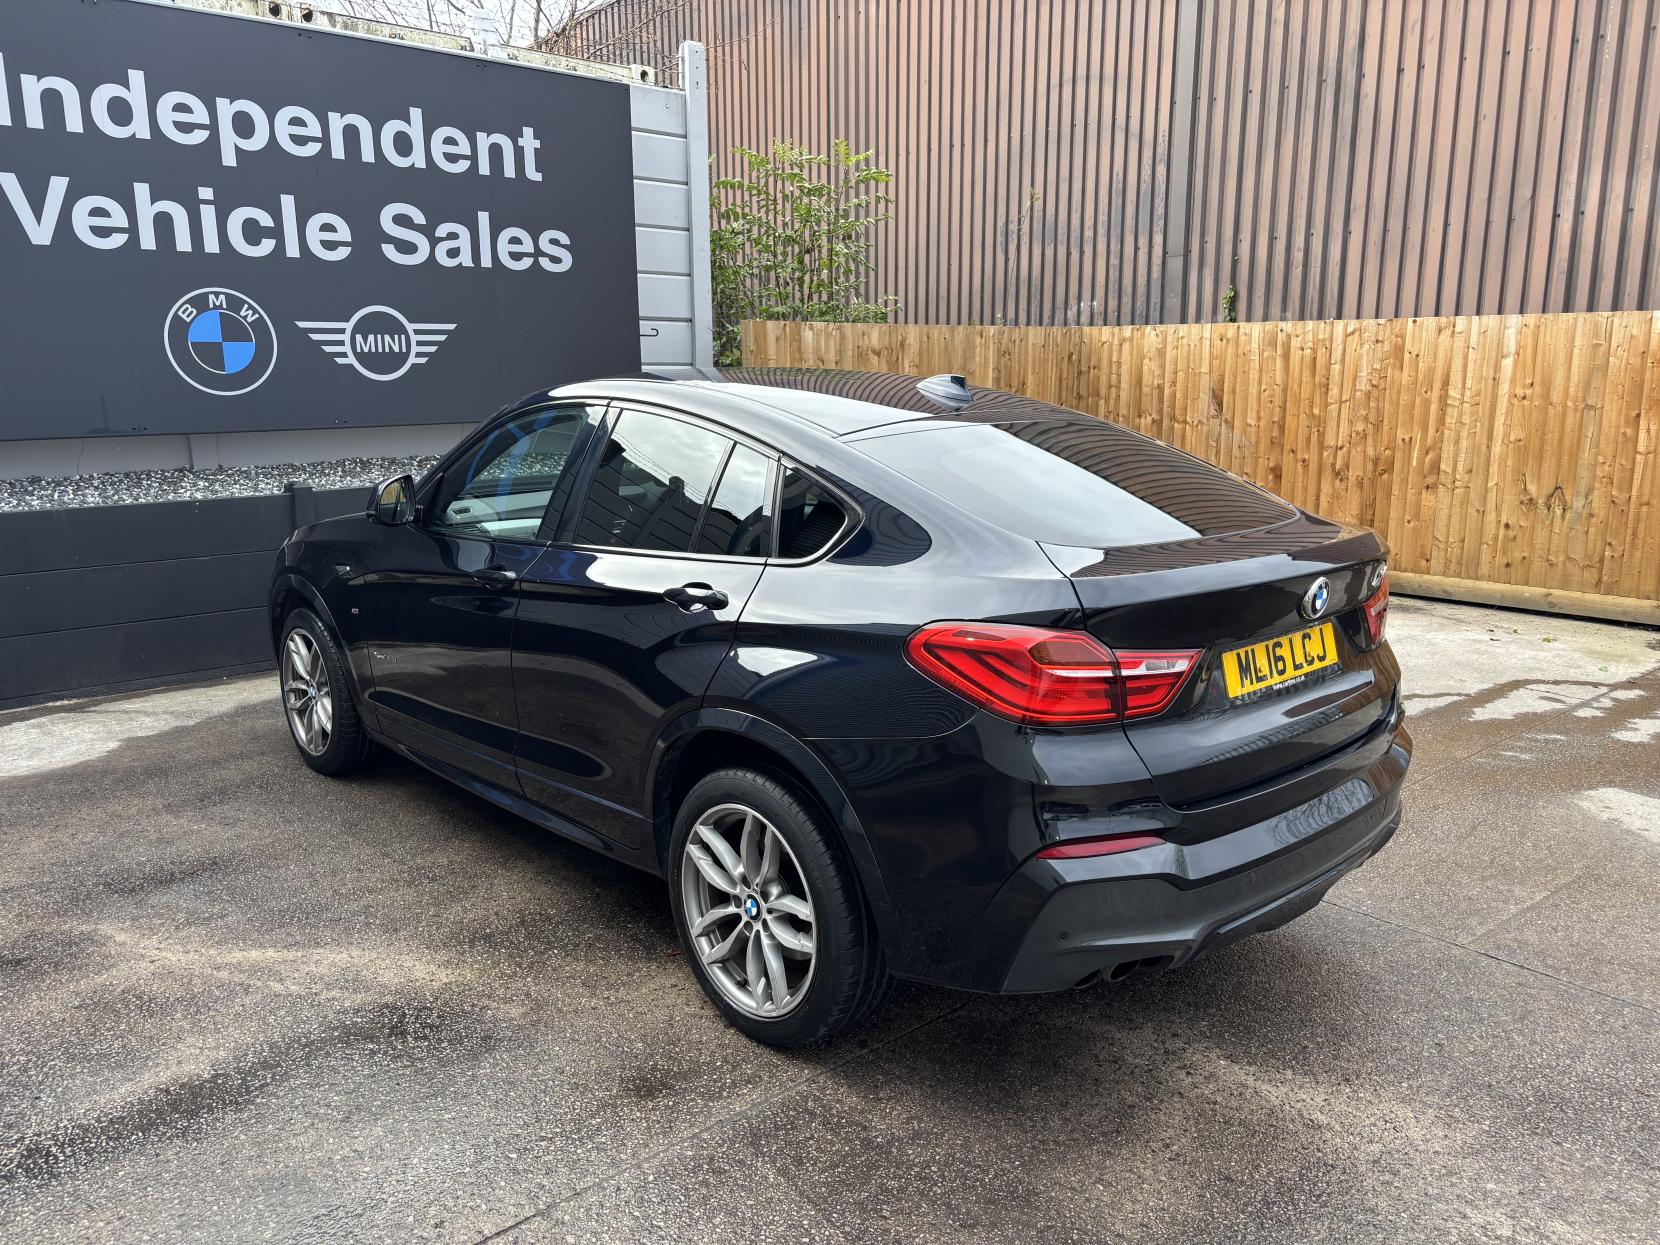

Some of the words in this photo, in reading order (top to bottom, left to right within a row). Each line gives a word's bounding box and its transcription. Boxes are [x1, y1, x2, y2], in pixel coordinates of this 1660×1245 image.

[0, 172, 352, 262] Vehicle
[380, 203, 573, 273] Sales
[178, 293, 260, 323] BMW
[355, 333, 407, 353] MINI
[1236, 641, 1287, 688] ML16
[1289, 628, 1327, 671] LCJ
